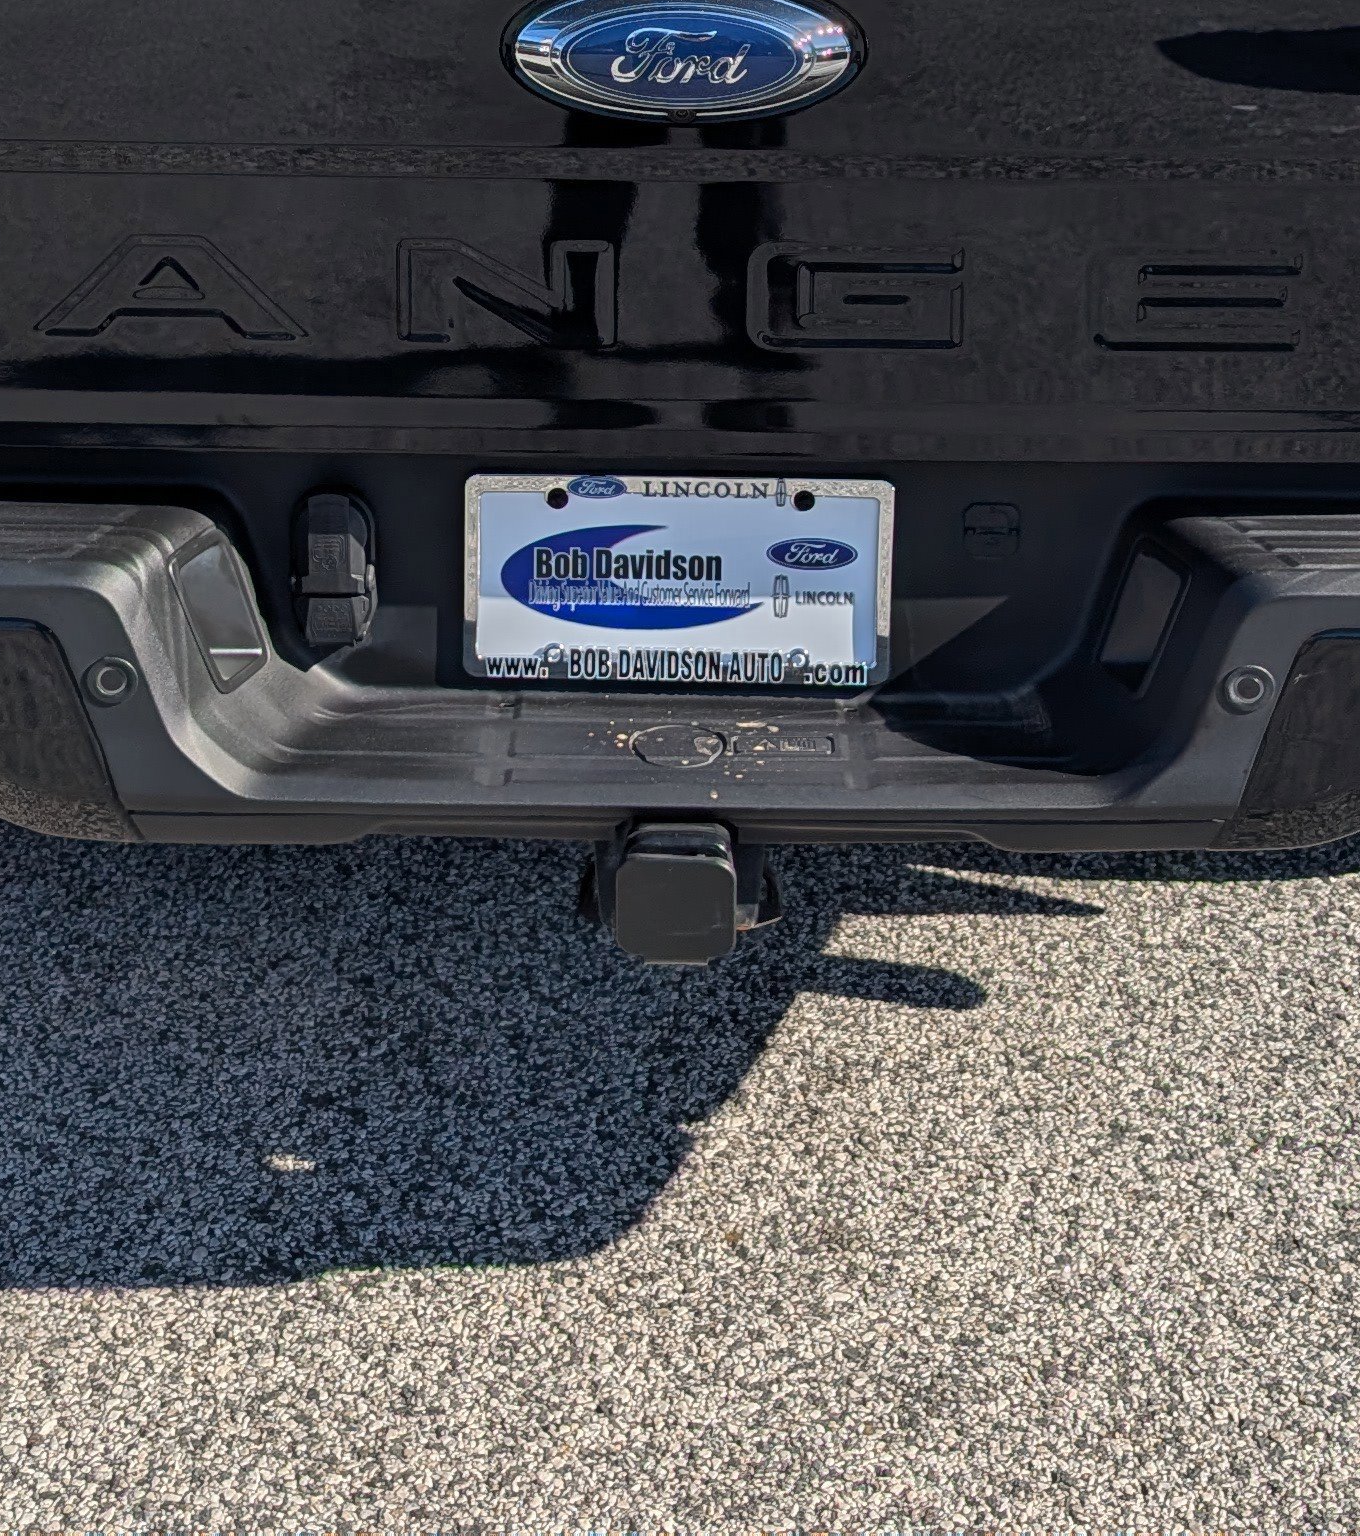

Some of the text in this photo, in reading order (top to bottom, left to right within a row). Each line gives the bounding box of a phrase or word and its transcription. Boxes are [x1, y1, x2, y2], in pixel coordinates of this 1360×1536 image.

[611, 26, 751, 86] Ford
[643, 480, 769, 499] LINCOLN
[534, 547, 723, 581] Bob Davidson
[784, 542, 840, 566] Ford
[641, 581, 683, 607] Customer
[683, 582, 714, 607] Service
[715, 582, 751, 609] Forward
[796, 590, 854, 606] LINCOLN
[486, 648, 868, 684] www. BOB DAVIDSON AUTO .com
